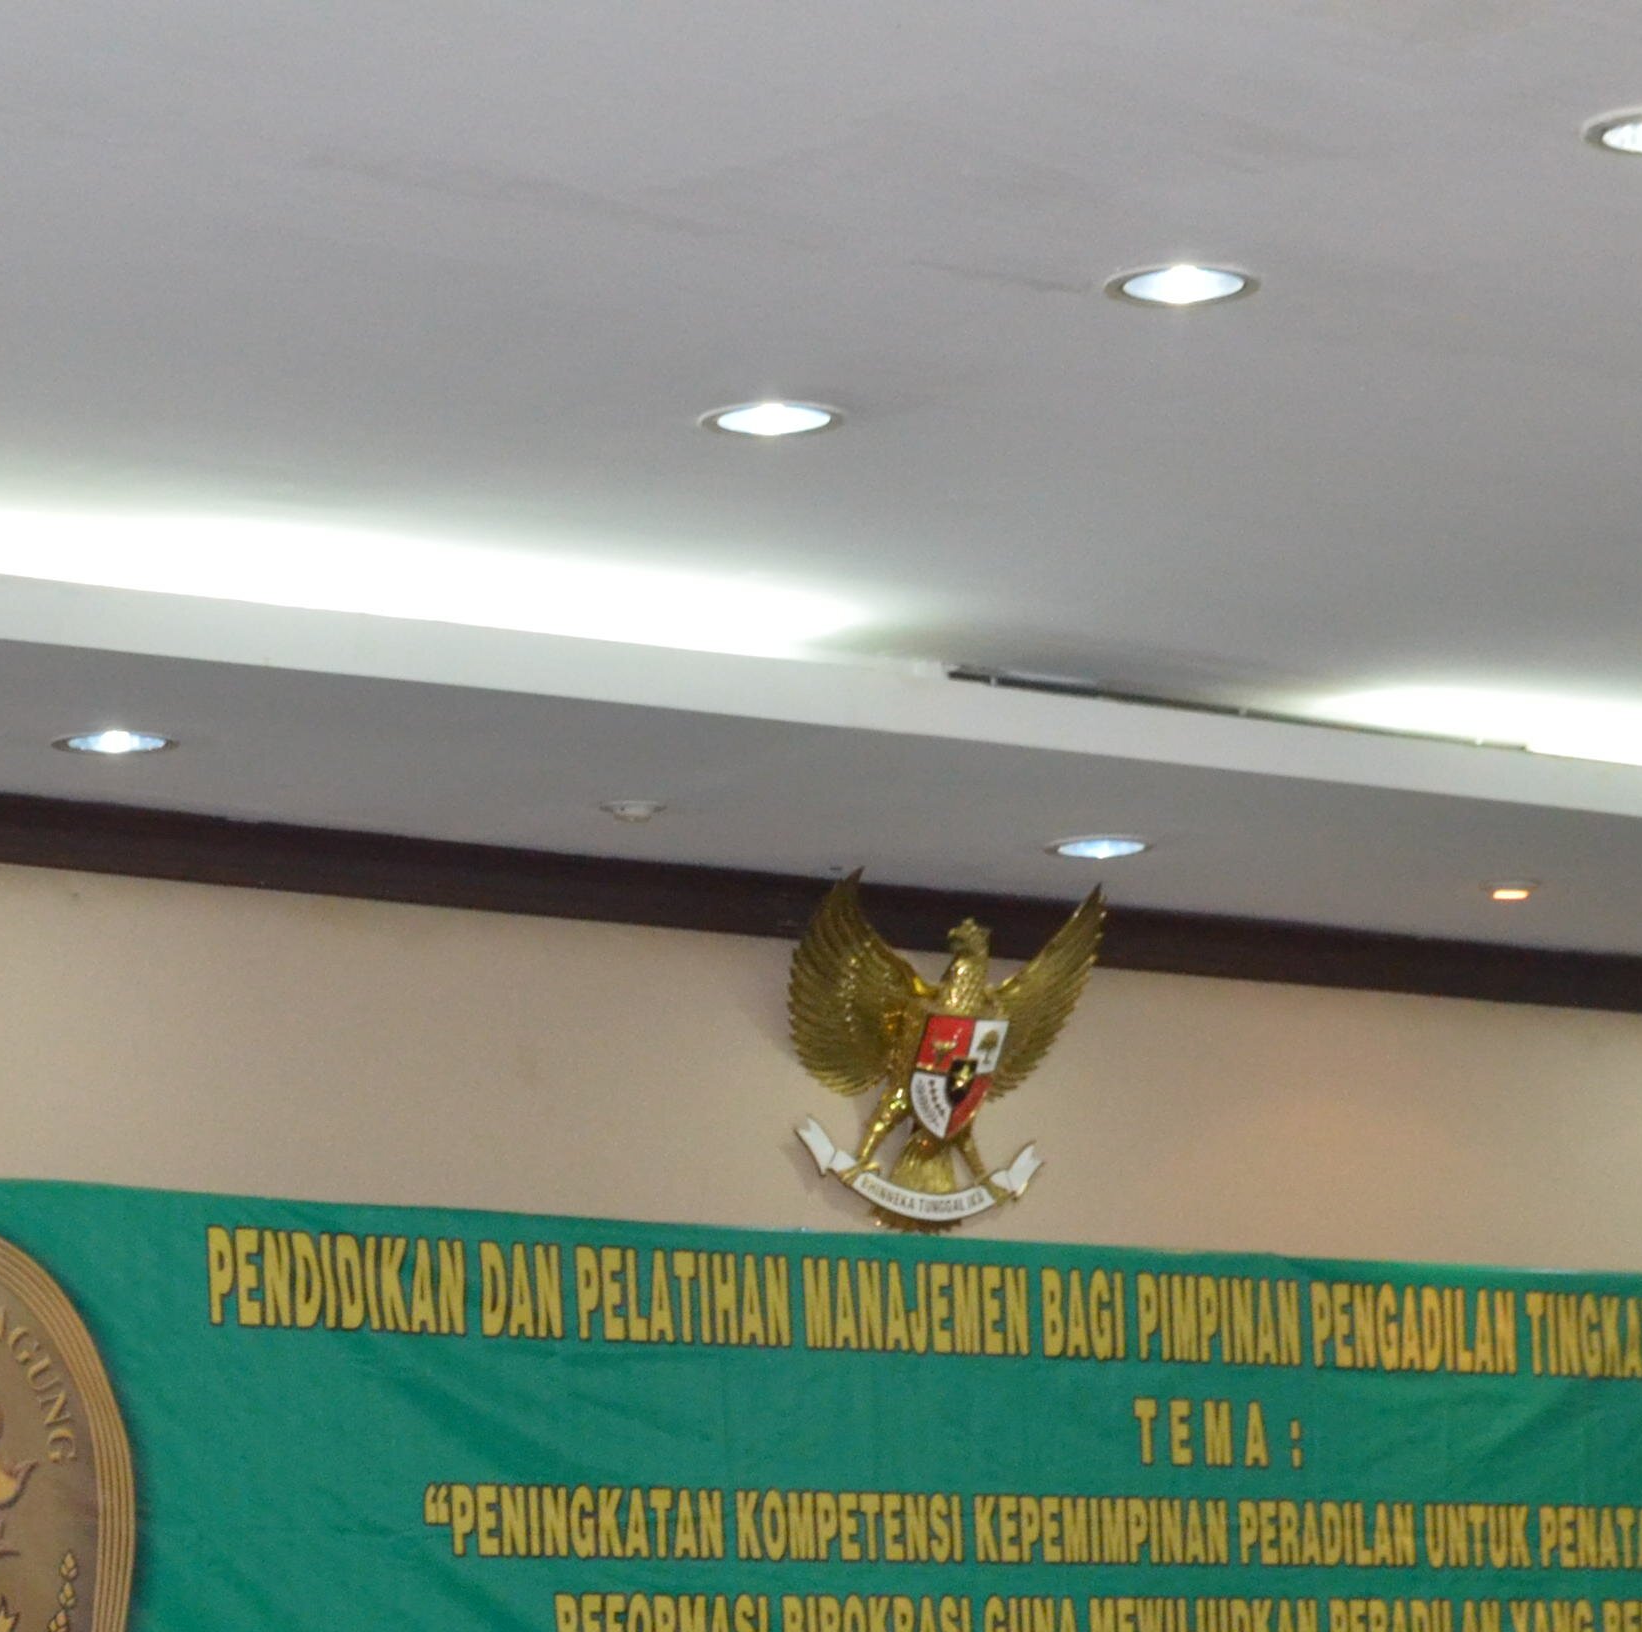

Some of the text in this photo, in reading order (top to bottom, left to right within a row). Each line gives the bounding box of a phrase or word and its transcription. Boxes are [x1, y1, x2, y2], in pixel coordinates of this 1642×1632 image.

[206, 1225, 467, 1335] PENDIDIKAN
[479, 1240, 564, 1339] DAN
[574, 1244, 793, 1347] PELATIHAN
[801, 1256, 1031, 1356] MANAJEMEN
[1040, 1267, 1127, 1361] BAGI
[1136, 1271, 1303, 1367] PIMPINAN
[1309, 1280, 1518, 1375] PENGADILAN
[735, 1488, 965, 1564] KOMPETENSI
[973, 1494, 1230, 1565] KEPEMIMPINAN
[1237, 1499, 1418, 1568] PERADILAN
[1424, 1502, 1532, 1570] UNTUK
